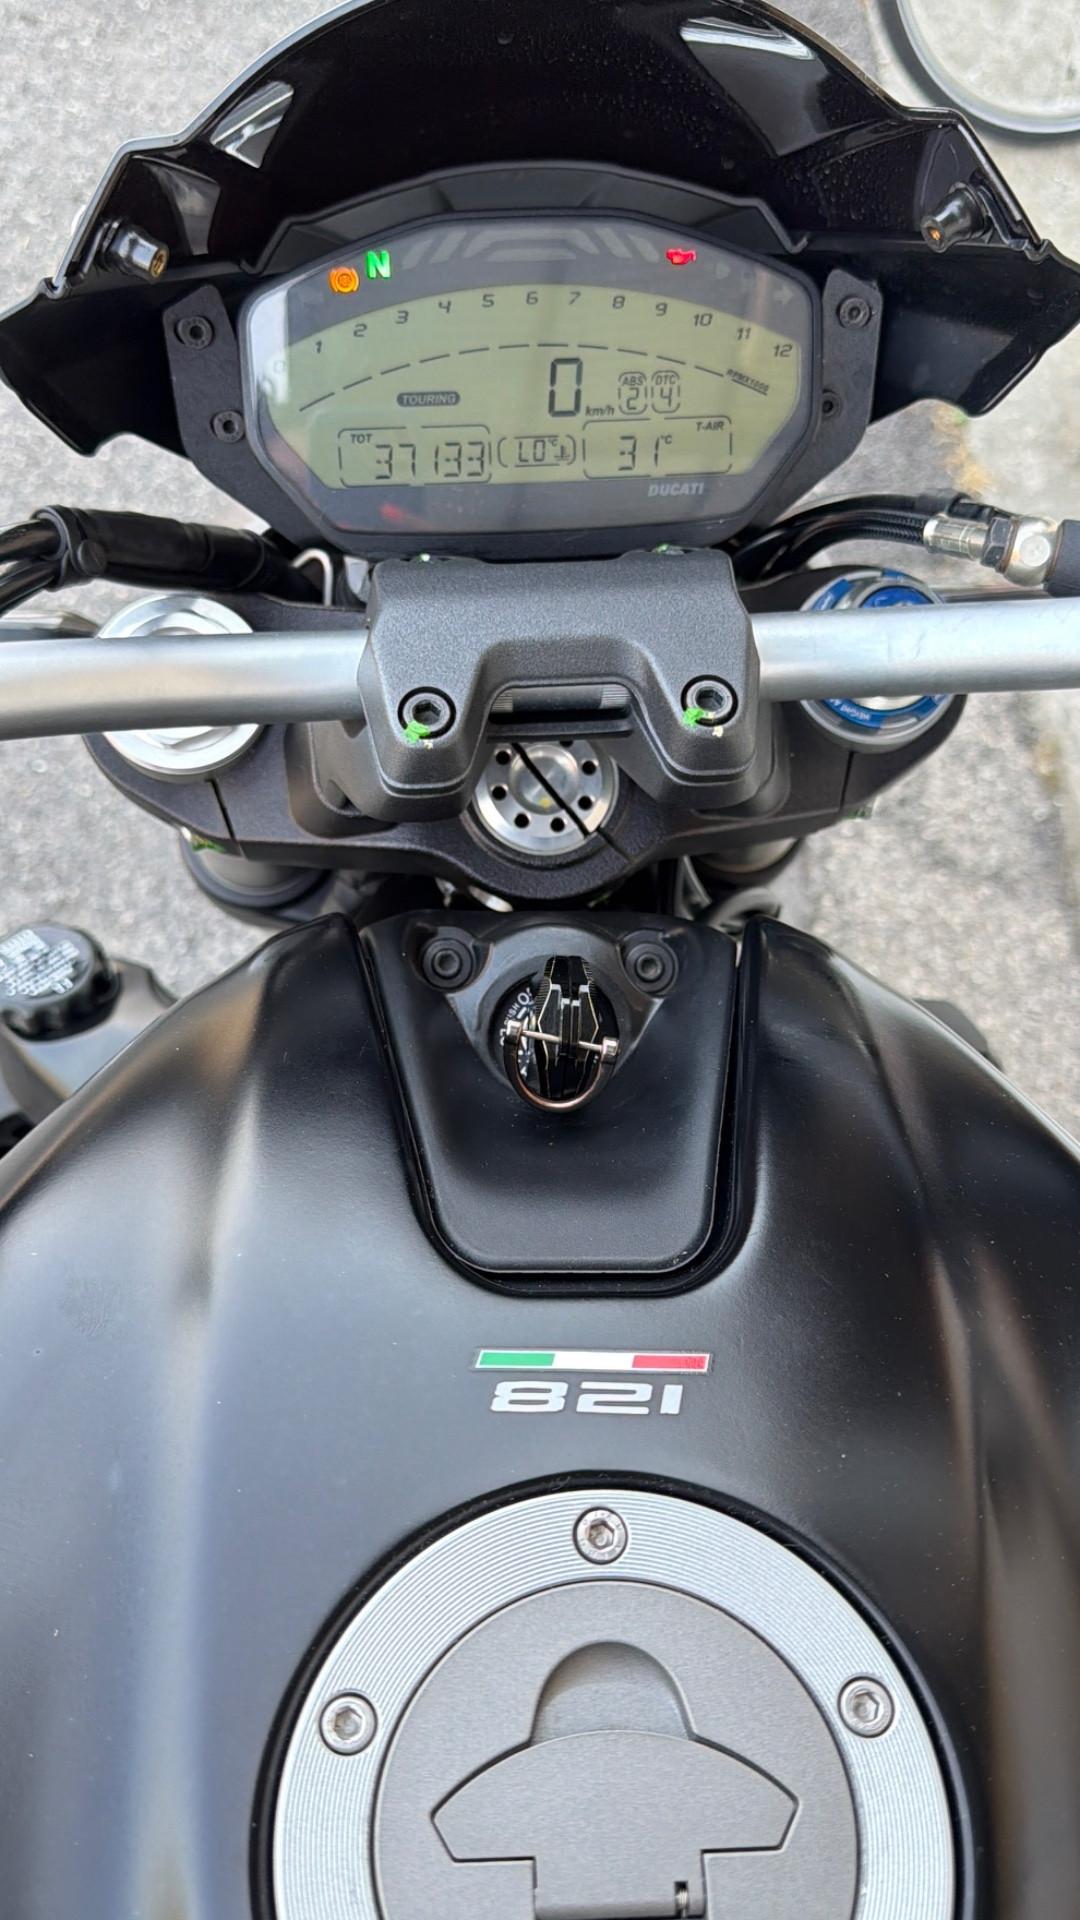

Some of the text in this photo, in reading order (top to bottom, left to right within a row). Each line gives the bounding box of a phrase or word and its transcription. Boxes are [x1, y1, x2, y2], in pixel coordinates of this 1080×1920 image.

[367, 250, 391, 279] N
[315, 340, 323, 354] 1
[353, 323, 368, 338] 2
[395, 311, 410, 324] 3
[438, 300, 452, 314] 4
[482, 294, 495, 308] 5
[526, 291, 539, 305] 6
[568, 291, 581, 305] 7
[612, 295, 626, 309] 8
[655, 302, 668, 317] 9
[693, 313, 713, 327] 10
[736, 327, 751, 341] 11
[773, 343, 793, 358] 12
[548, 357, 615, 418] 0 km/h
[622, 375, 644, 387] ABS
[655, 374, 677, 386] DTC
[402, 393, 457, 406] TOURING
[626, 387, 640, 410] 2
[660, 386, 673, 408] 4
[696, 420, 725, 432] T-AIR
[351, 433, 372, 444] TOT
[375, 441, 485, 480] 37133
[647, 482, 705, 497] DUCATI
[490, 1380, 684, 1415] 821
